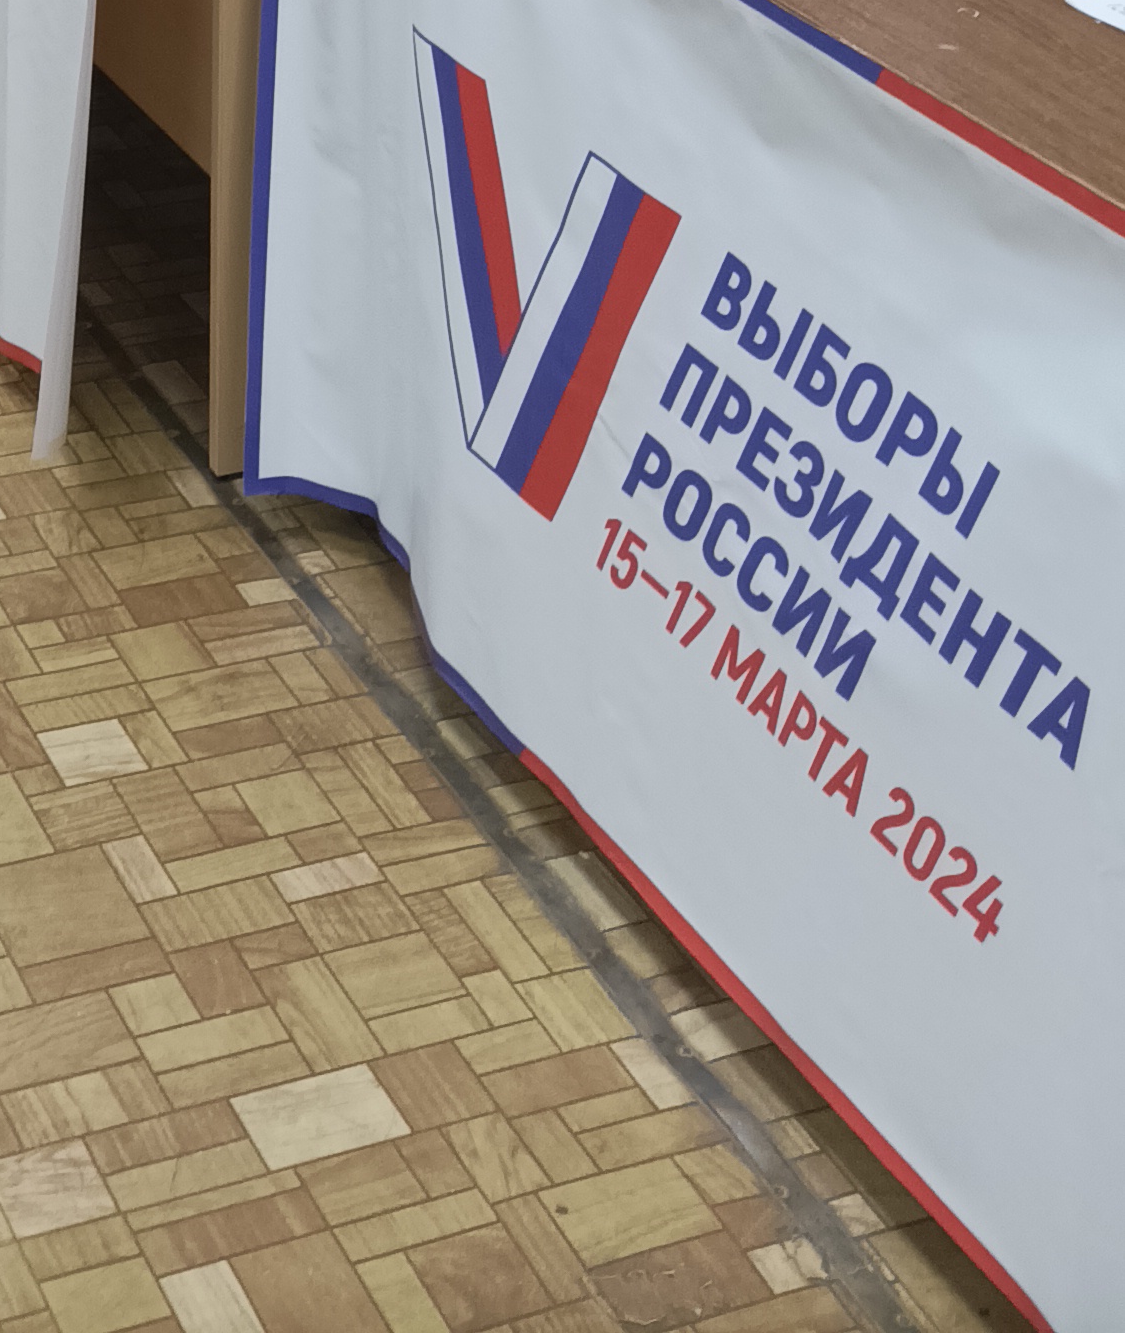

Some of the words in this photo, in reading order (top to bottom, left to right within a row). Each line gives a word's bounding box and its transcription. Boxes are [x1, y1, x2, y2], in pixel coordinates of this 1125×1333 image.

[701, 251, 1000, 540] ВЫБОРЫ
[621, 432, 876, 702] РОССИИ
[659, 343, 1091, 771] ПРЕЗИДЕНТА
[710, 624, 869, 818] МАРТА
[870, 787, 1003, 944] 2024
